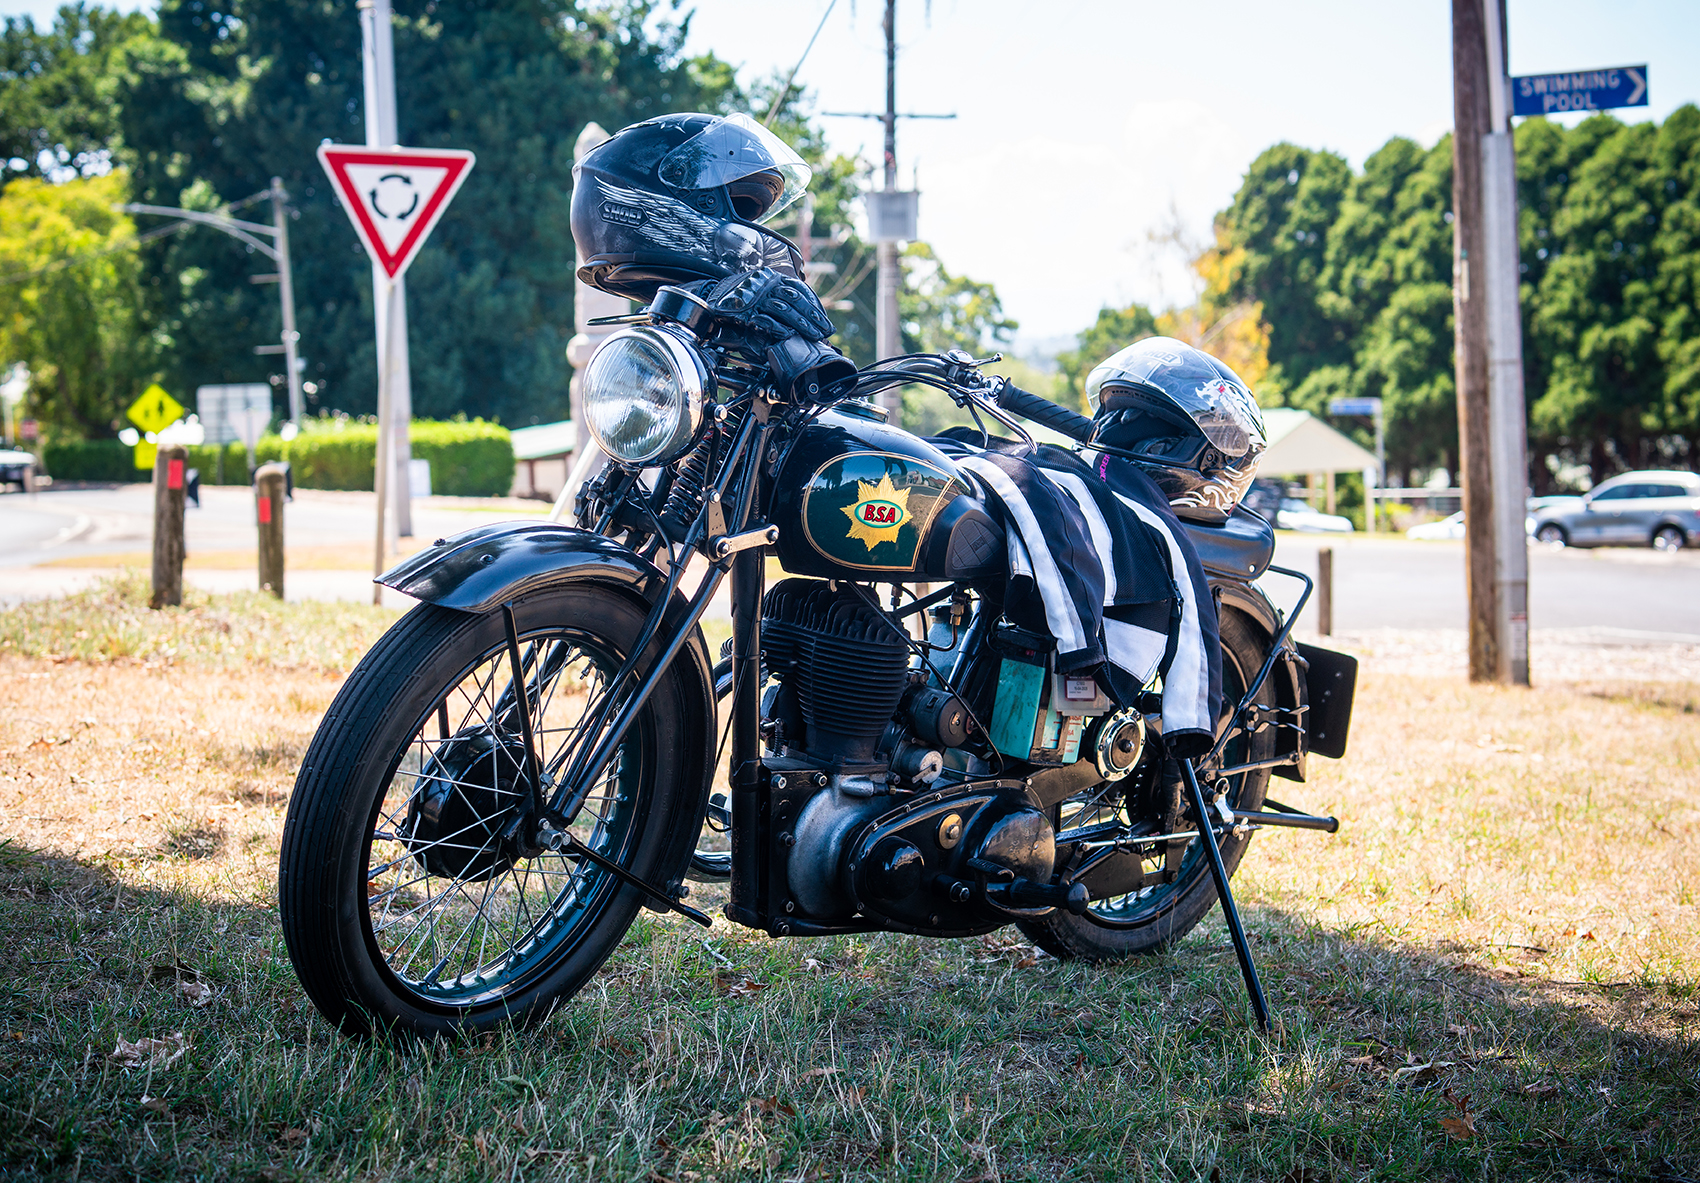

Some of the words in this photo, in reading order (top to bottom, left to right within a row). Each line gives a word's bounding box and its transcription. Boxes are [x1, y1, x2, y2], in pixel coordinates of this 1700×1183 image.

[1520, 69, 1620, 97] SWIMMING
[1543, 91, 1597, 113] POOL
[602, 203, 642, 226] SHOEI
